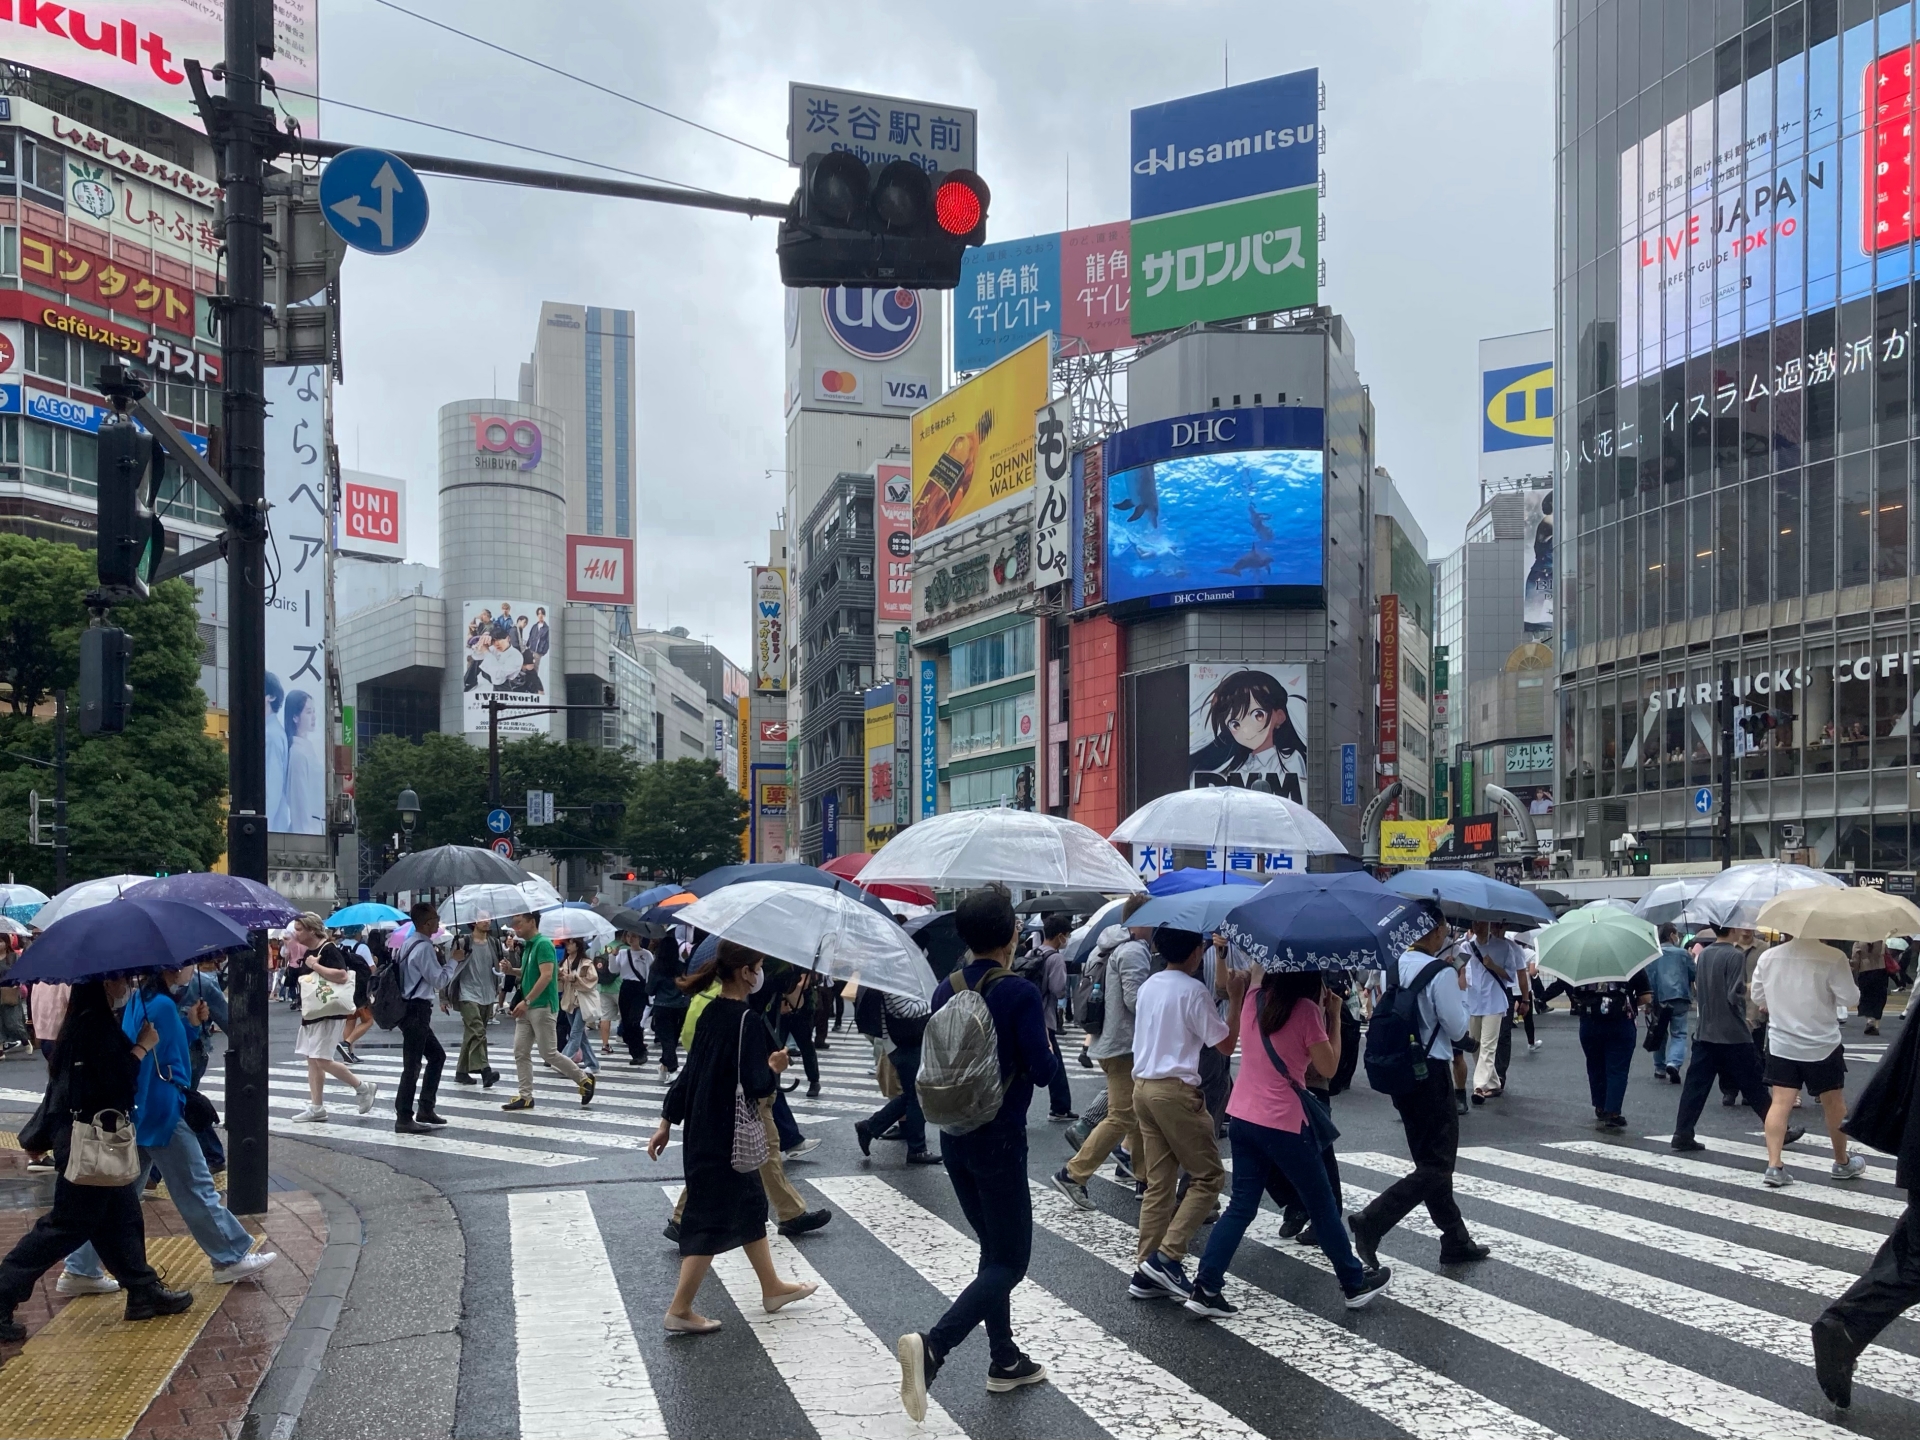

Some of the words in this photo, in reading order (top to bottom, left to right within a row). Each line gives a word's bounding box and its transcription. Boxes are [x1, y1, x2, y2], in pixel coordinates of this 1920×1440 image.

[806, 98, 961, 152] 渋谷駅前
[1131, 123, 1314, 176] Hisamitsu
[1640, 215, 1699, 268] LIVE
[1710, 161, 1824, 235] JAPAN
[23, 236, 190, 320] コンタクト
[1142, 225, 1305, 298] サロンパス
[977, 263, 1039, 302] 龍角散
[547, 318, 581, 330] INDIGO
[967, 296, 1051, 334] ダイレクト
[147, 338, 219, 382] ガスト
[884, 381, 928, 400] VISA
[35, 395, 88, 425] AEON
[470, 414, 542, 471] 109
[1171, 417, 1236, 448] DHC
[475, 456, 517, 471] SHIBUYA
[990, 447, 1033, 482] JOHNNI
[990, 465, 1033, 497] WALKE
[352, 490, 389, 514] UNI
[1037, 406, 1068, 578] もんじゃ
[352, 513, 393, 535] QLO
[584, 558, 617, 582] H&M
[1174, 593, 1195, 604] DHC
[1196, 590, 1235, 602] Channel
[1383, 599, 1395, 691] クスリのことなら
[923, 683, 934, 792] サマーフルーツギフト
[1382, 699, 1397, 755] 三千里
